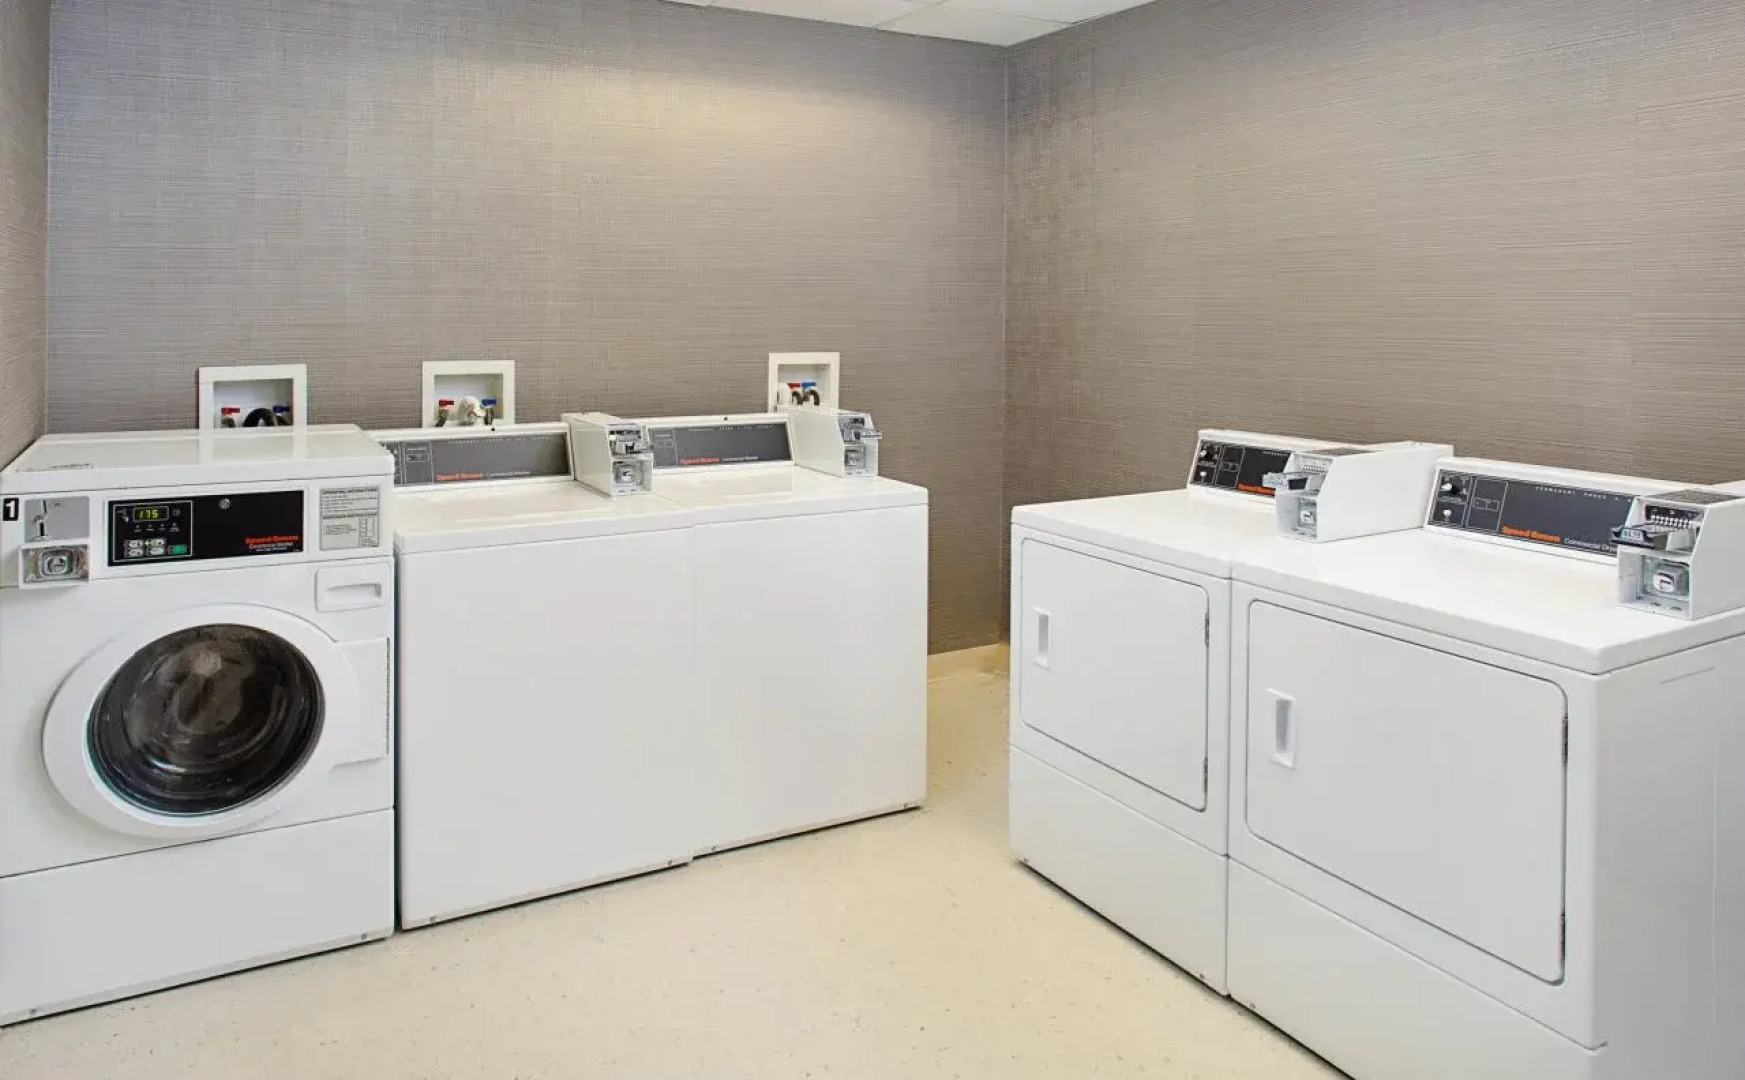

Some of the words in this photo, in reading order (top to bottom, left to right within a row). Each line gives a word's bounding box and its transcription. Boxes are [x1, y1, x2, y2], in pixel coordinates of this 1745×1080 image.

[460, 472, 484, 480] Queen
[1238, 483, 1257, 492] Speed
[5, 501, 16, 518] 1
[139, 509, 160, 519] 175
[1502, 525, 1531, 538] Speed
[1531, 529, 1561, 543] Queen
[245, 536, 271, 545] Speed
[1564, 537, 1601, 549] Commercial
[1602, 544, 1617, 553] Drye
